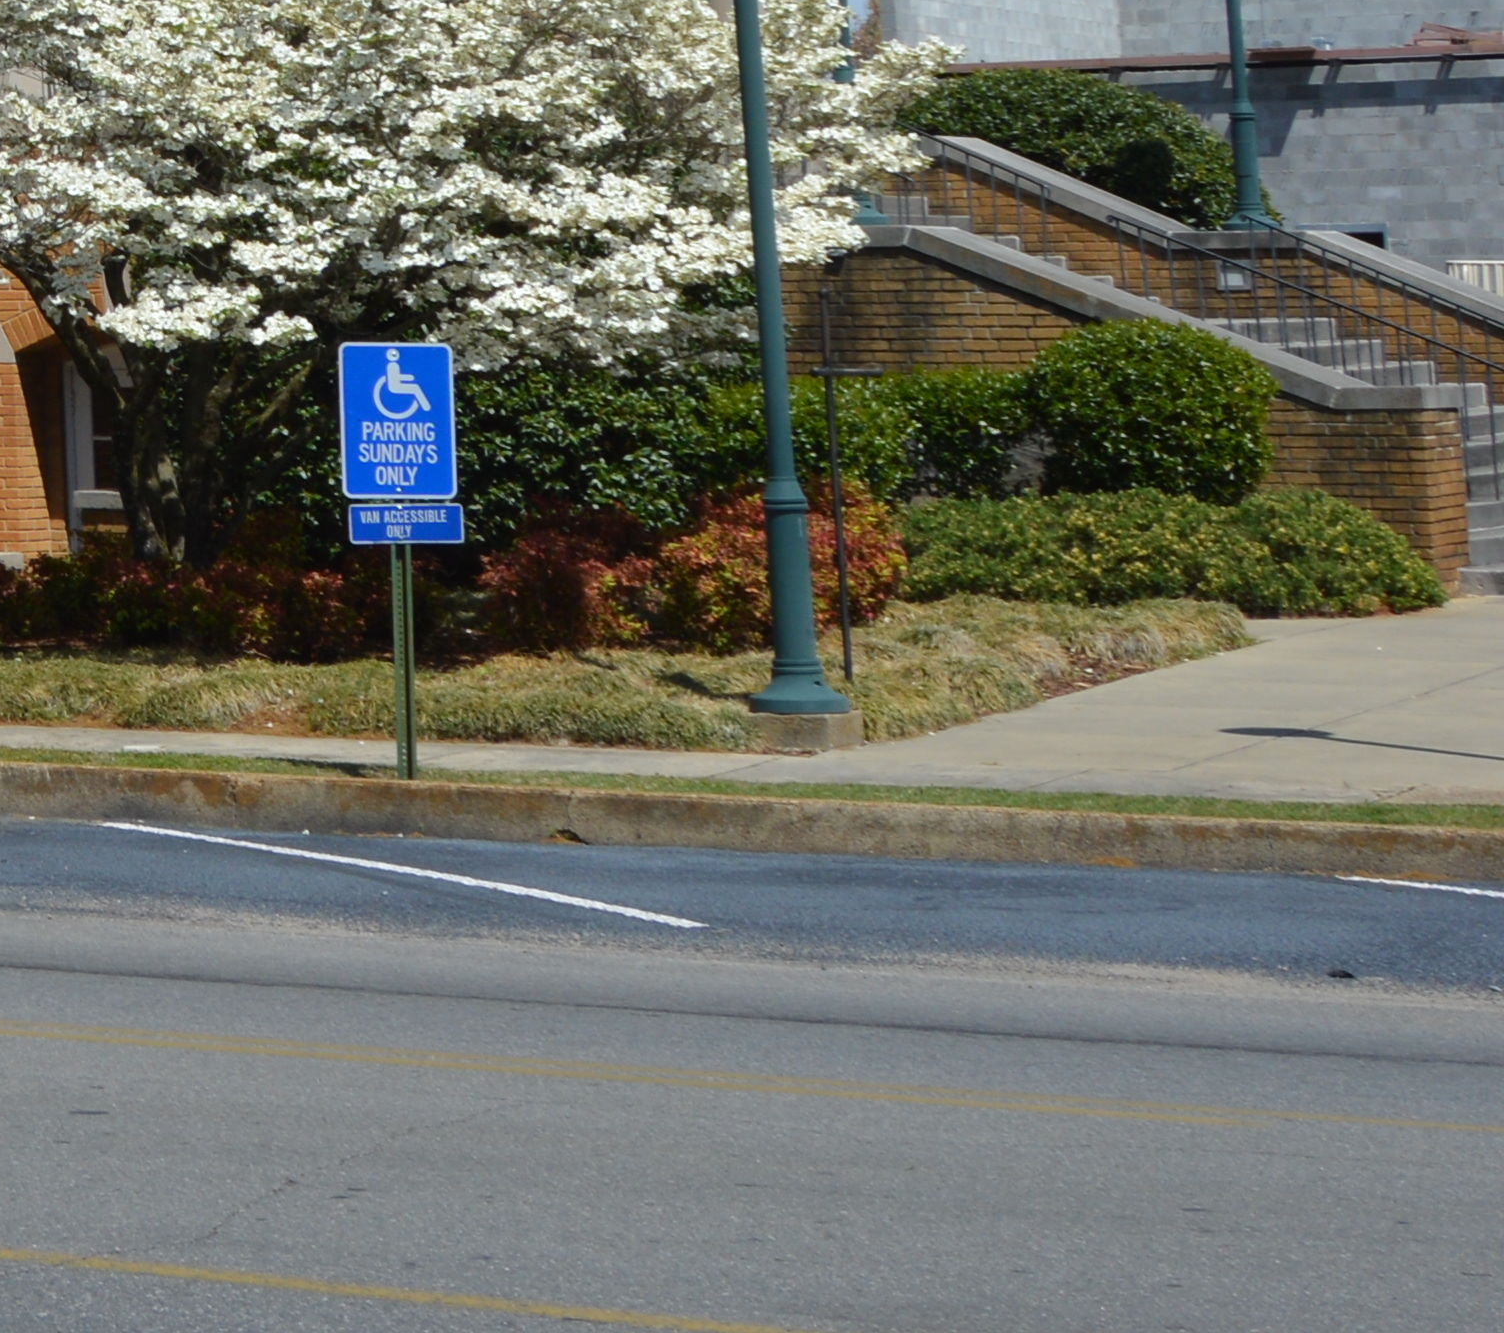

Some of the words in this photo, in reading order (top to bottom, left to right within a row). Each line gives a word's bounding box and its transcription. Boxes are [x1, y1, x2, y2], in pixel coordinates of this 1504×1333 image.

[362, 422, 436, 442] PARKING
[359, 443, 438, 464] SUNDAYS
[375, 466, 418, 485] ONLY
[360, 511, 379, 523] VAN
[384, 509, 447, 523] ACCESSIBLE
[387, 525, 412, 537] ONLY
